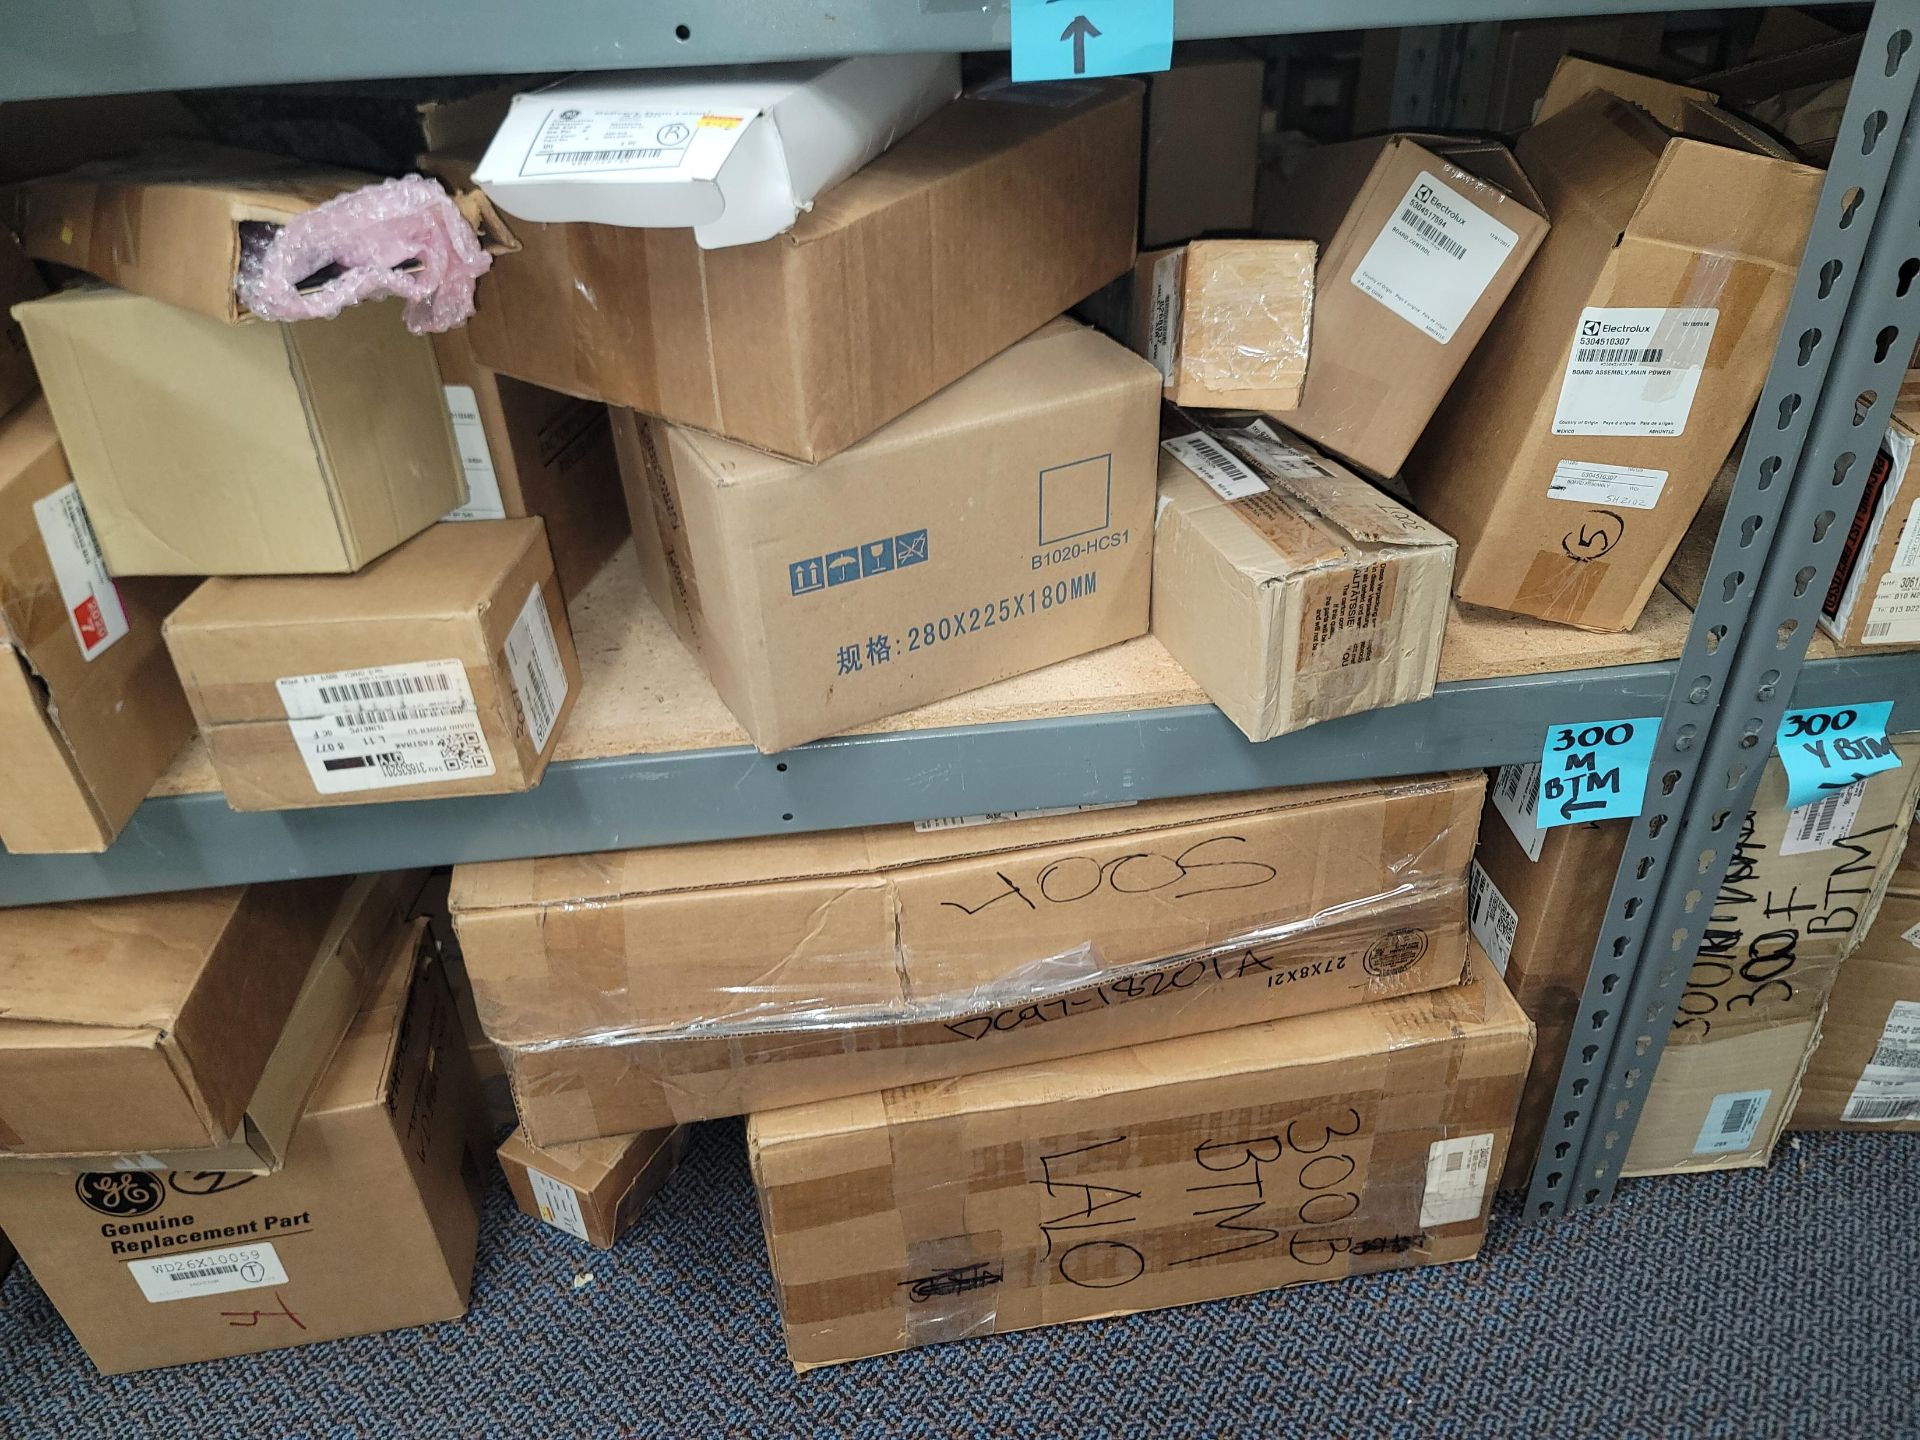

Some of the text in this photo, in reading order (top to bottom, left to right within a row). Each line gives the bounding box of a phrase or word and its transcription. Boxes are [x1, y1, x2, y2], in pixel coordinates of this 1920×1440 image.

[1409, 199, 1448, 228] 5304517594
[1430, 196, 1466, 226] Electrolux
[1580, 337, 1630, 346] 5304510307
[1603, 324, 1650, 334] Electrolux
[1031, 530, 1130, 571] B1020-HCS1
[1362, 593, 1373, 628] Verpackung
[1371, 582, 1383, 617] Verpackung
[1553, 722, 1634, 752] 300
[1784, 709, 1858, 738] 300
[1565, 752, 1596, 772] M
[1802, 735, 1899, 769] Y BTM
[1545, 767, 1621, 801] BTM
[1807, 823, 1899, 935] BTM
[1267, 955, 1347, 989] 27X8X21
[1167, 1135, 1284, 1267] BTM
[1286, 1107, 1362, 1267] 300B
[101, 1213, 195, 1238] Genuine
[110, 1210, 311, 1255] Replacement Part
[152, 1249, 261, 1275] WD26X10059
